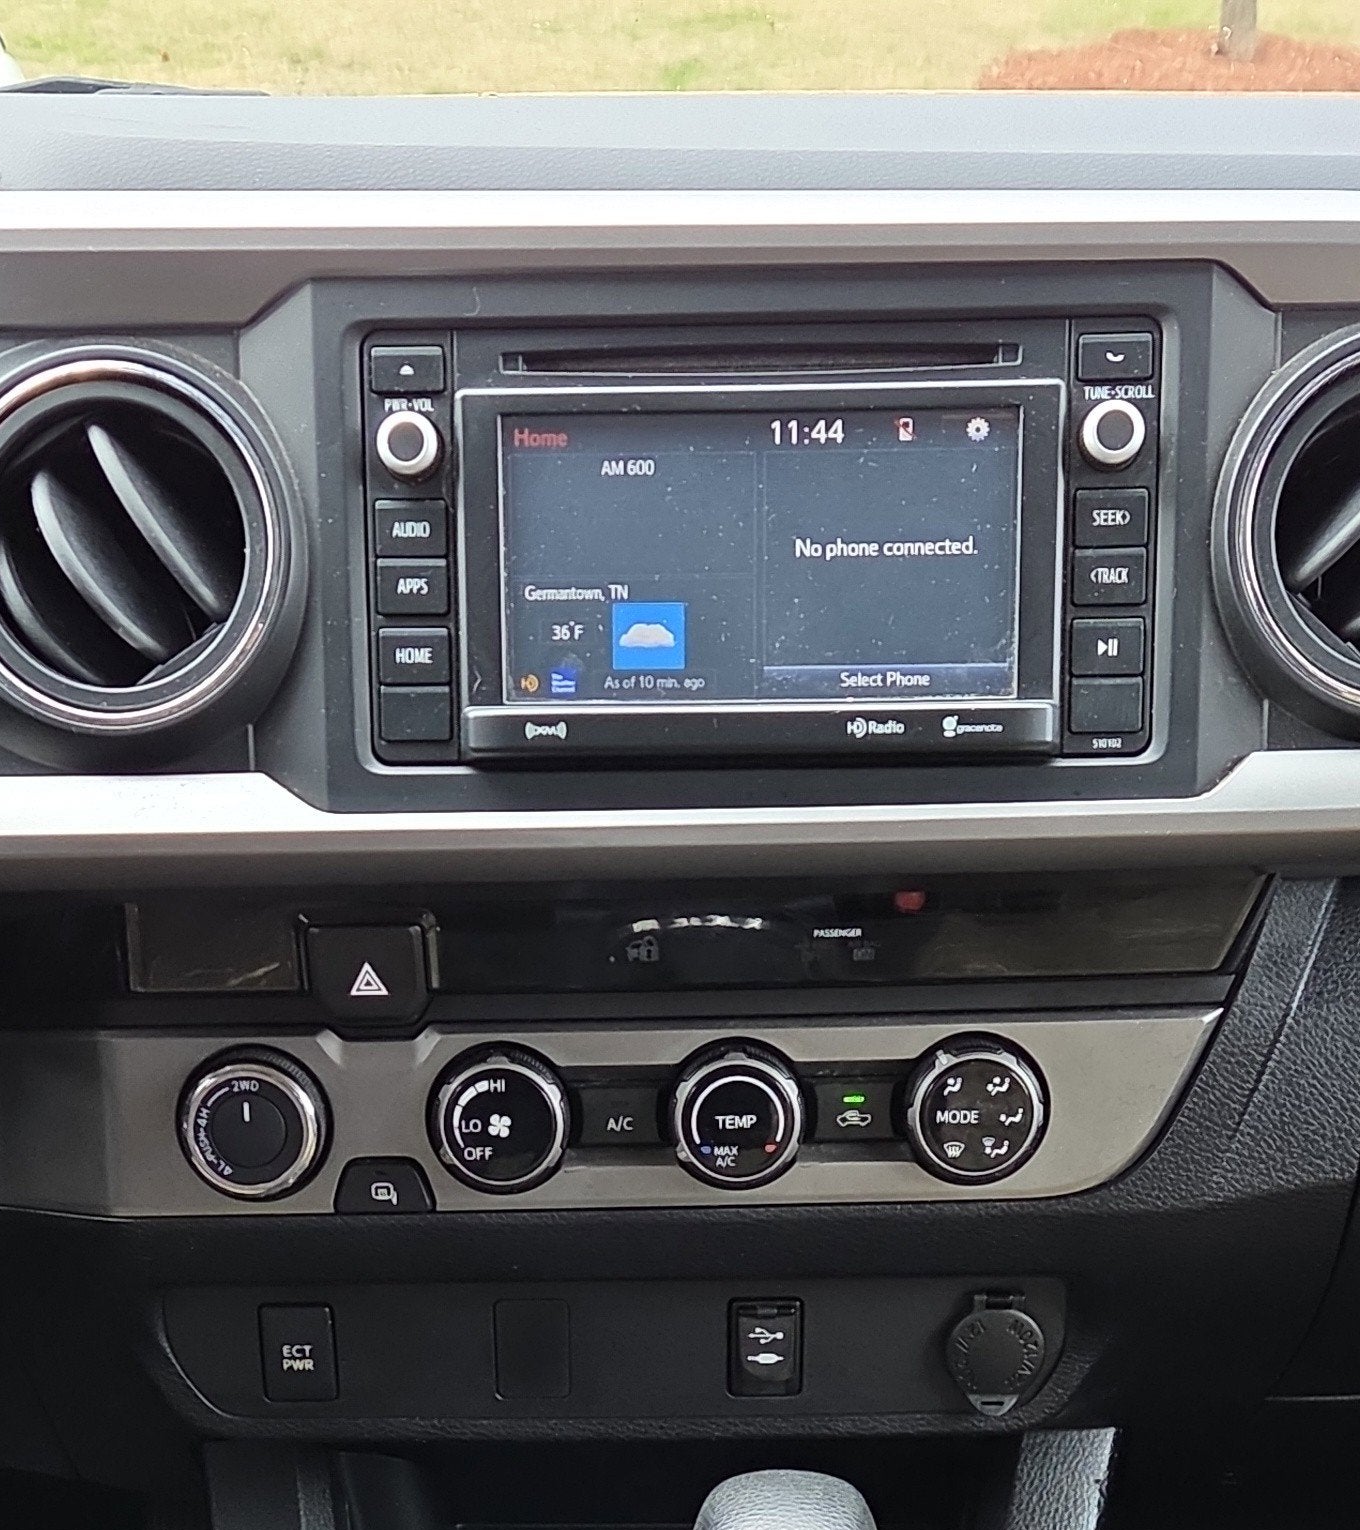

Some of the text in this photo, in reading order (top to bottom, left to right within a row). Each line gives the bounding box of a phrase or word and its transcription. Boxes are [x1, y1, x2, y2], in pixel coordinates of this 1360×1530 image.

[513, 427, 569, 448] Home
[770, 418, 845, 445] 11:44
[600, 459, 656, 476] AM 600
[1092, 509, 1124, 526] SEEK
[391, 521, 431, 538] AUDIO
[794, 534, 979, 561] No phone connected.
[1096, 567, 1130, 584] TRACK
[396, 578, 429, 595] APPS
[524, 584, 629, 602] Germantown, TN
[551, 620, 585, 641] 36°F
[395, 647, 434, 664] HOME
[603, 674, 706, 691] As of 10 min. ago
[840, 671, 931, 687] Select Phone
[868, 719, 905, 735] Radio
[813, 928, 862, 938] PASSENGER
[231, 1080, 260, 1093] 2WD
[489, 1078, 506, 1093] HI
[461, 1118, 482, 1133] LO
[606, 1115, 634, 1132] A/C
[714, 1114, 758, 1130] TEMP
[935, 1110, 980, 1125] MODE
[463, 1146, 493, 1161] OFF
[713, 1145, 739, 1156] MAX
[715, 1156, 736, 1168] A/C
[282, 1344, 313, 1357] ECT
[282, 1358, 314, 1371] PWR
